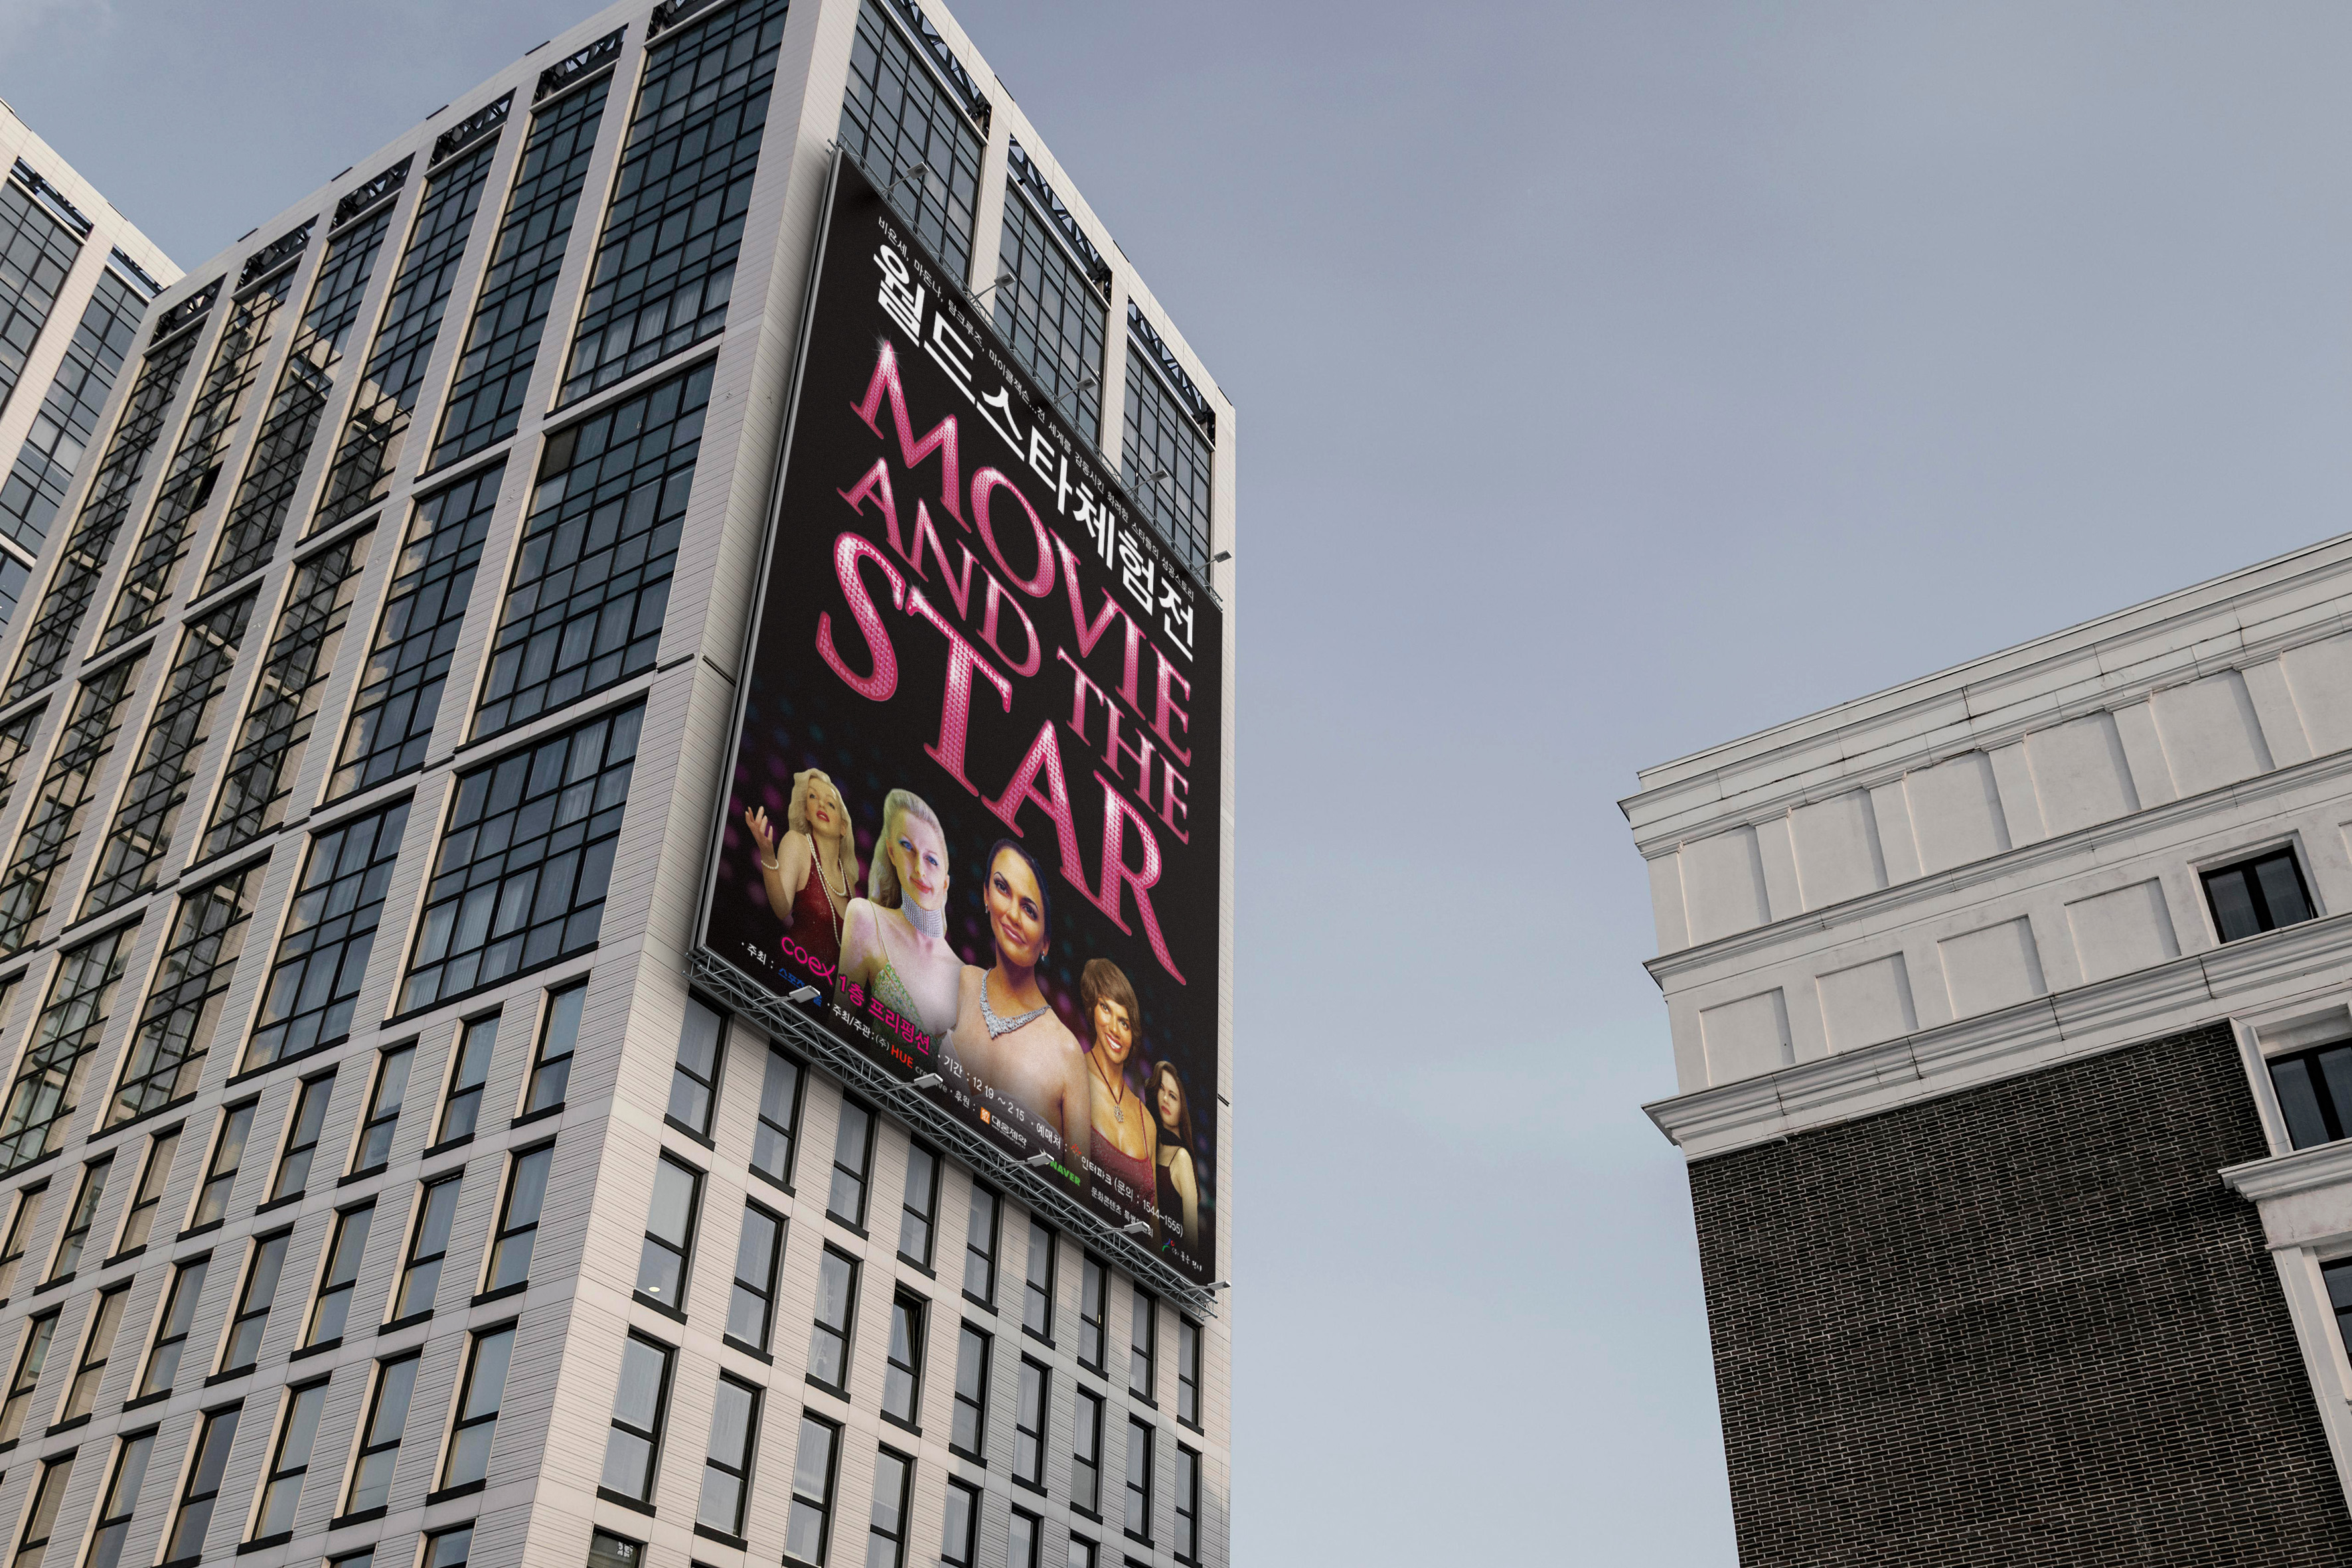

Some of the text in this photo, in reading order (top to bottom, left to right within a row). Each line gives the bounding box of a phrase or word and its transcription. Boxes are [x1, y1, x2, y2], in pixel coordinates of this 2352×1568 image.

[850, 340, 1191, 767] MOVIE
[873, 245, 1194, 663] 월드스타체험전
[878, 216, 909, 262] 비욘세,
[913, 259, 943, 303] 마돈나,
[948, 299, 984, 352] 탐크루즈,
[1048, 422, 1071, 455] 세계를
[1075, 451, 1104, 495] 감동시킨
[1107, 491, 1129, 524] 화려한
[1131, 522, 1159, 560] 스타들의
[1161, 556, 1194, 603] 성공스토리
[815, 532, 1186, 985] STAR
[837, 457, 1189, 845] AND THE
[778, 968, 823, 1007] 스포츠울
[891, 1044, 913, 1069] HUE
[915, 1066, 947, 1093] creve
[1050, 1156, 1081, 1186] NAVER
[1124, 1210, 1153, 1238] 특별회
[839, 976, 864, 1006] 1층
[868, 997, 929, 1056] 프리펑션
[973, 1076, 982, 1091] 12
[1016, 1107, 1024, 1122] 15
[1081, 1156, 1112, 1186] 인터파크
